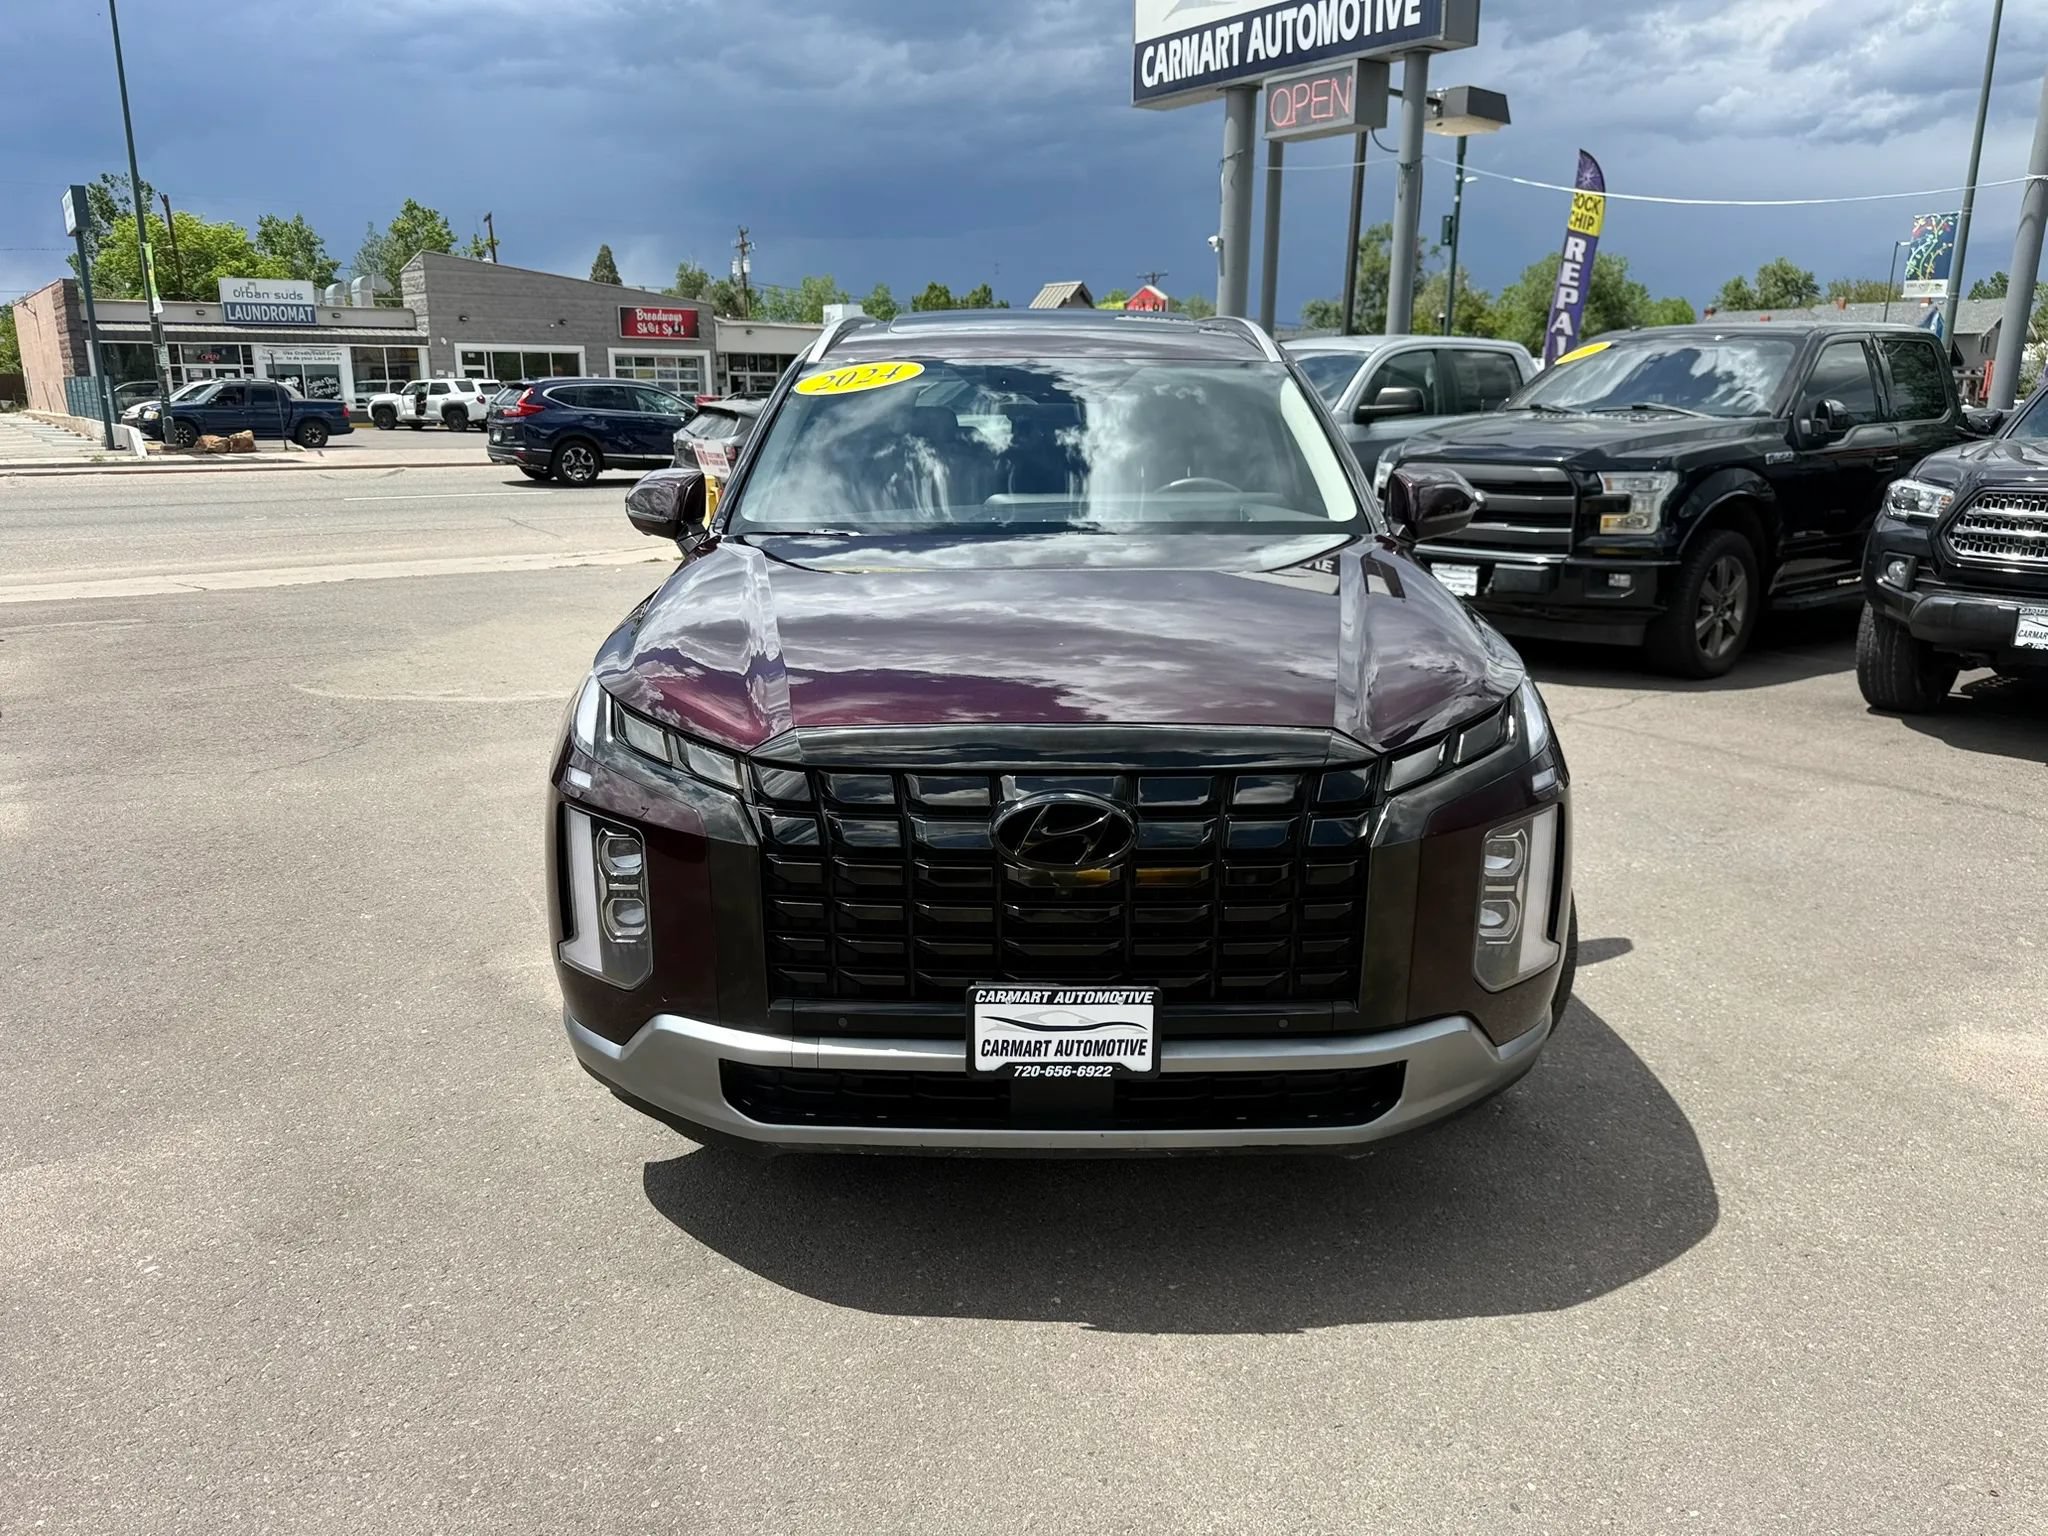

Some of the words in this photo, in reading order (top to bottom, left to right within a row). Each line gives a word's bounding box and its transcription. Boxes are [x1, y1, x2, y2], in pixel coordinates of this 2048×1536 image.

[1141, 21, 1244, 88] CARMART
[1246, 0, 1421, 63] AUTOMOTIVE
[1270, 75, 1353, 127] OPEN
[274, 290, 303, 300] suds
[227, 304, 312, 322] LAUNDROMAT
[814, 365, 903, 391] 2024
[975, 990, 1051, 1004] CARMART
[1053, 991, 1154, 1004] AUTOMOTIVE
[981, 1039, 1052, 1057] CARMART
[1054, 1039, 1148, 1057] AUTOMOTIVE
[1014, 1065, 1113, 1077] 720-656-6922
